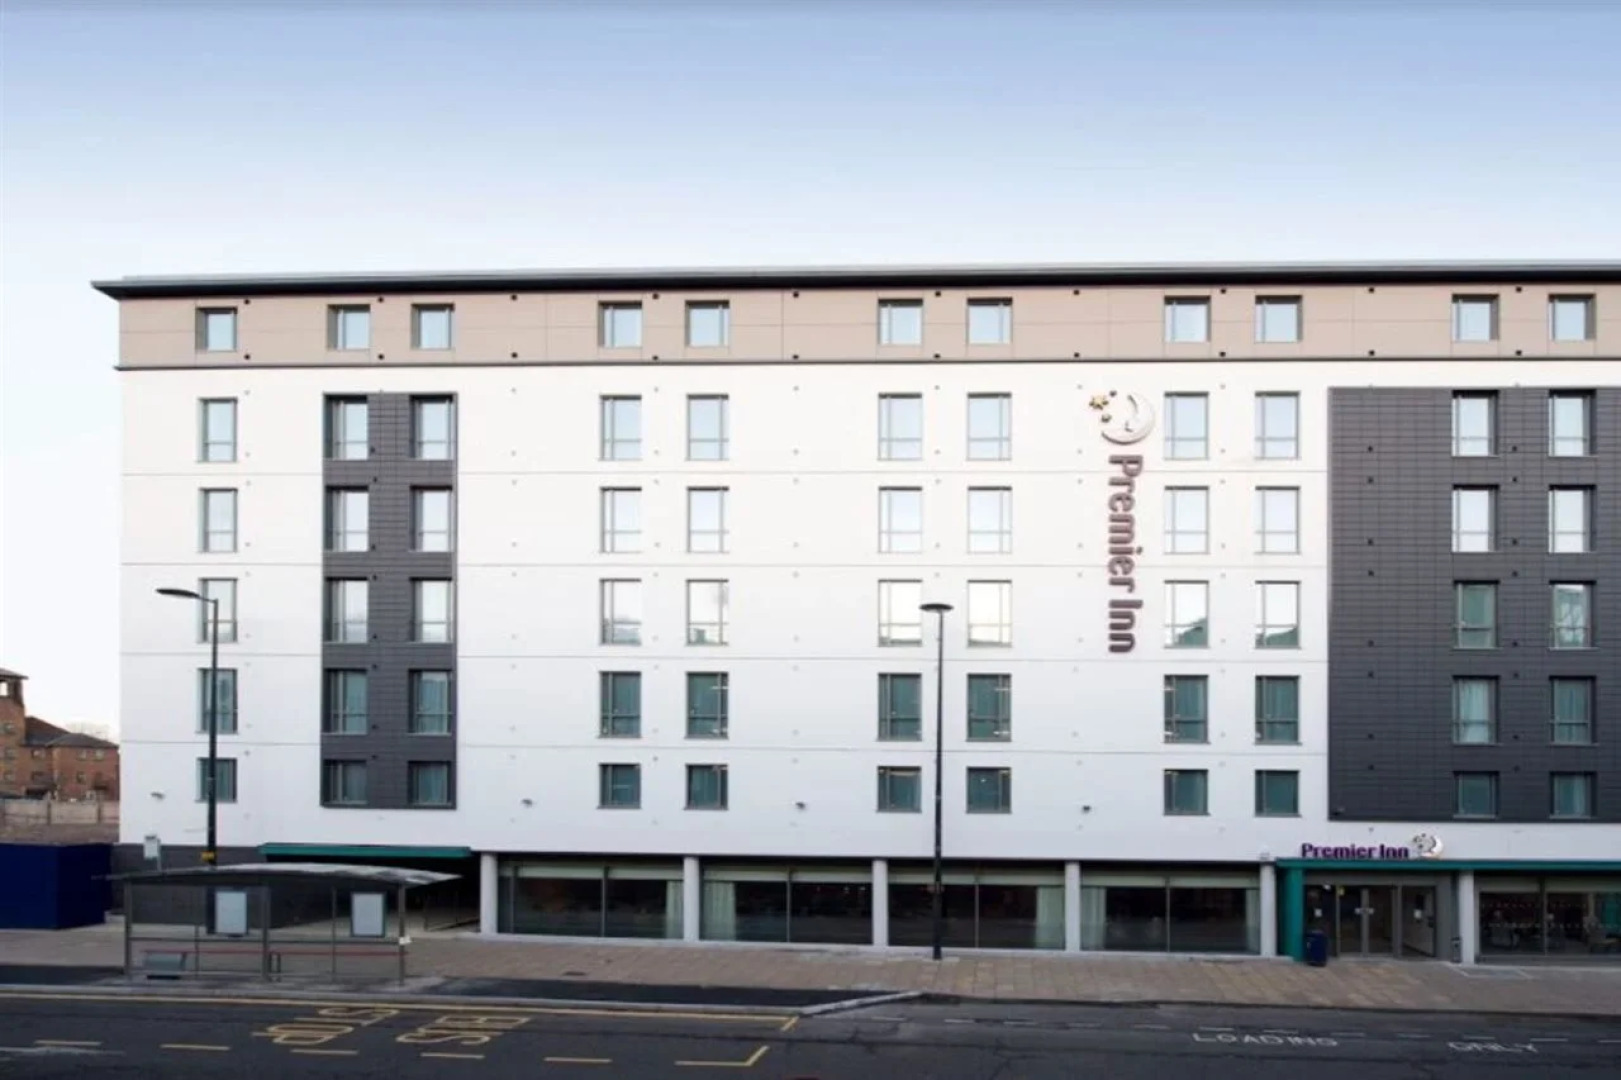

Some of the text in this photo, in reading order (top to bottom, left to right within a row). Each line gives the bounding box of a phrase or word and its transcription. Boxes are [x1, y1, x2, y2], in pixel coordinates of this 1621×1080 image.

[1108, 454, 1144, 653] Premier Inn
[1301, 842, 1409, 859] Premier Inn
[1193, 1032, 1338, 1047] LOADING
